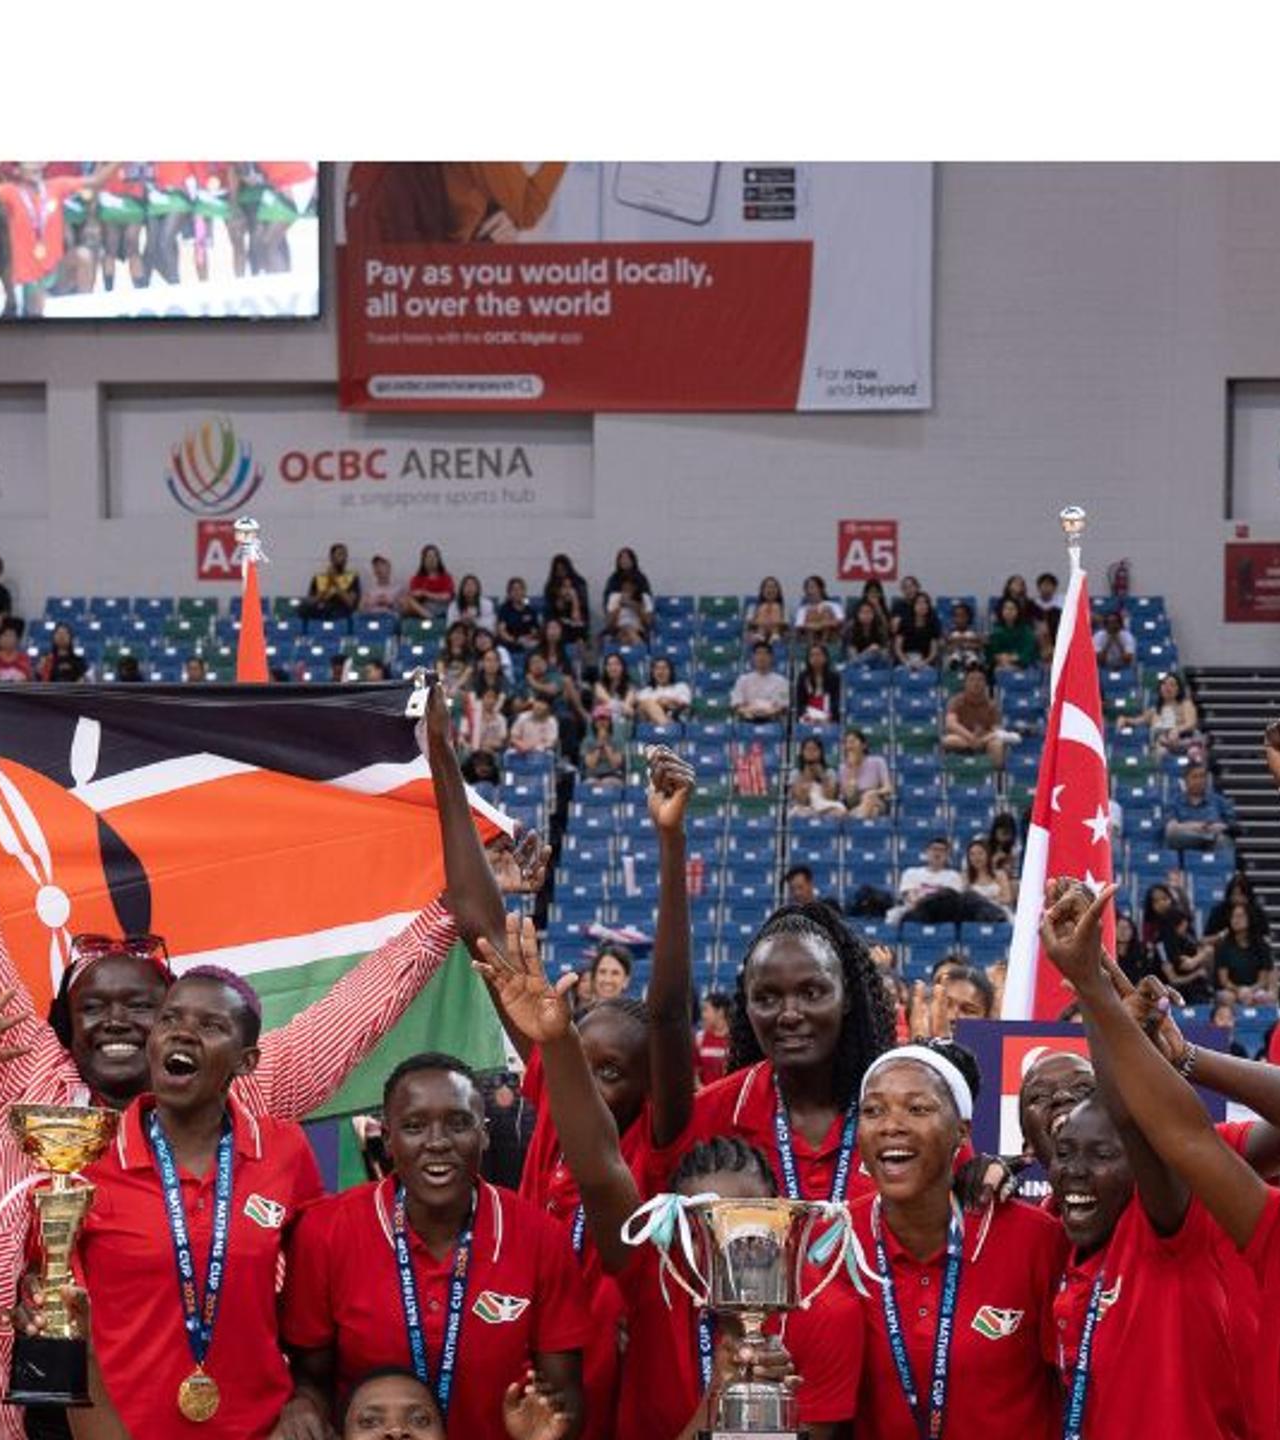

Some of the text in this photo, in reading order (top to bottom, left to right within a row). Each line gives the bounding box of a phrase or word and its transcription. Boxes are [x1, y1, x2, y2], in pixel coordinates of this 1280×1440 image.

[366, 259, 714, 289] Pay as you would locally,
[366, 291, 611, 317] all over the world
[484, 332, 519, 344] OCBC
[827, 382, 917, 400] and beyond
[279, 447, 534, 483] OCBC ARENA
[842, 538, 894, 573] A5
[776, 1116, 788, 1141] CUP
[168, 1188, 188, 1247] NATIONS
[178, 1249, 193, 1279] CUP
[213, 1200, 231, 1257] NATIONS
[397, 1238, 409, 1264] CUP
[208, 1262, 222, 1291] CUP
[400, 1269, 419, 1327] NATIONS
[441, 1313, 461, 1371] NATIONS
[451, 1281, 464, 1310] CUP
[700, 1325, 712, 1353] CUP
[935, 1317, 951, 1377] NATIONS
[1076, 1312, 1095, 1371] NATIONS
[932, 1379, 945, 1407] CUP
